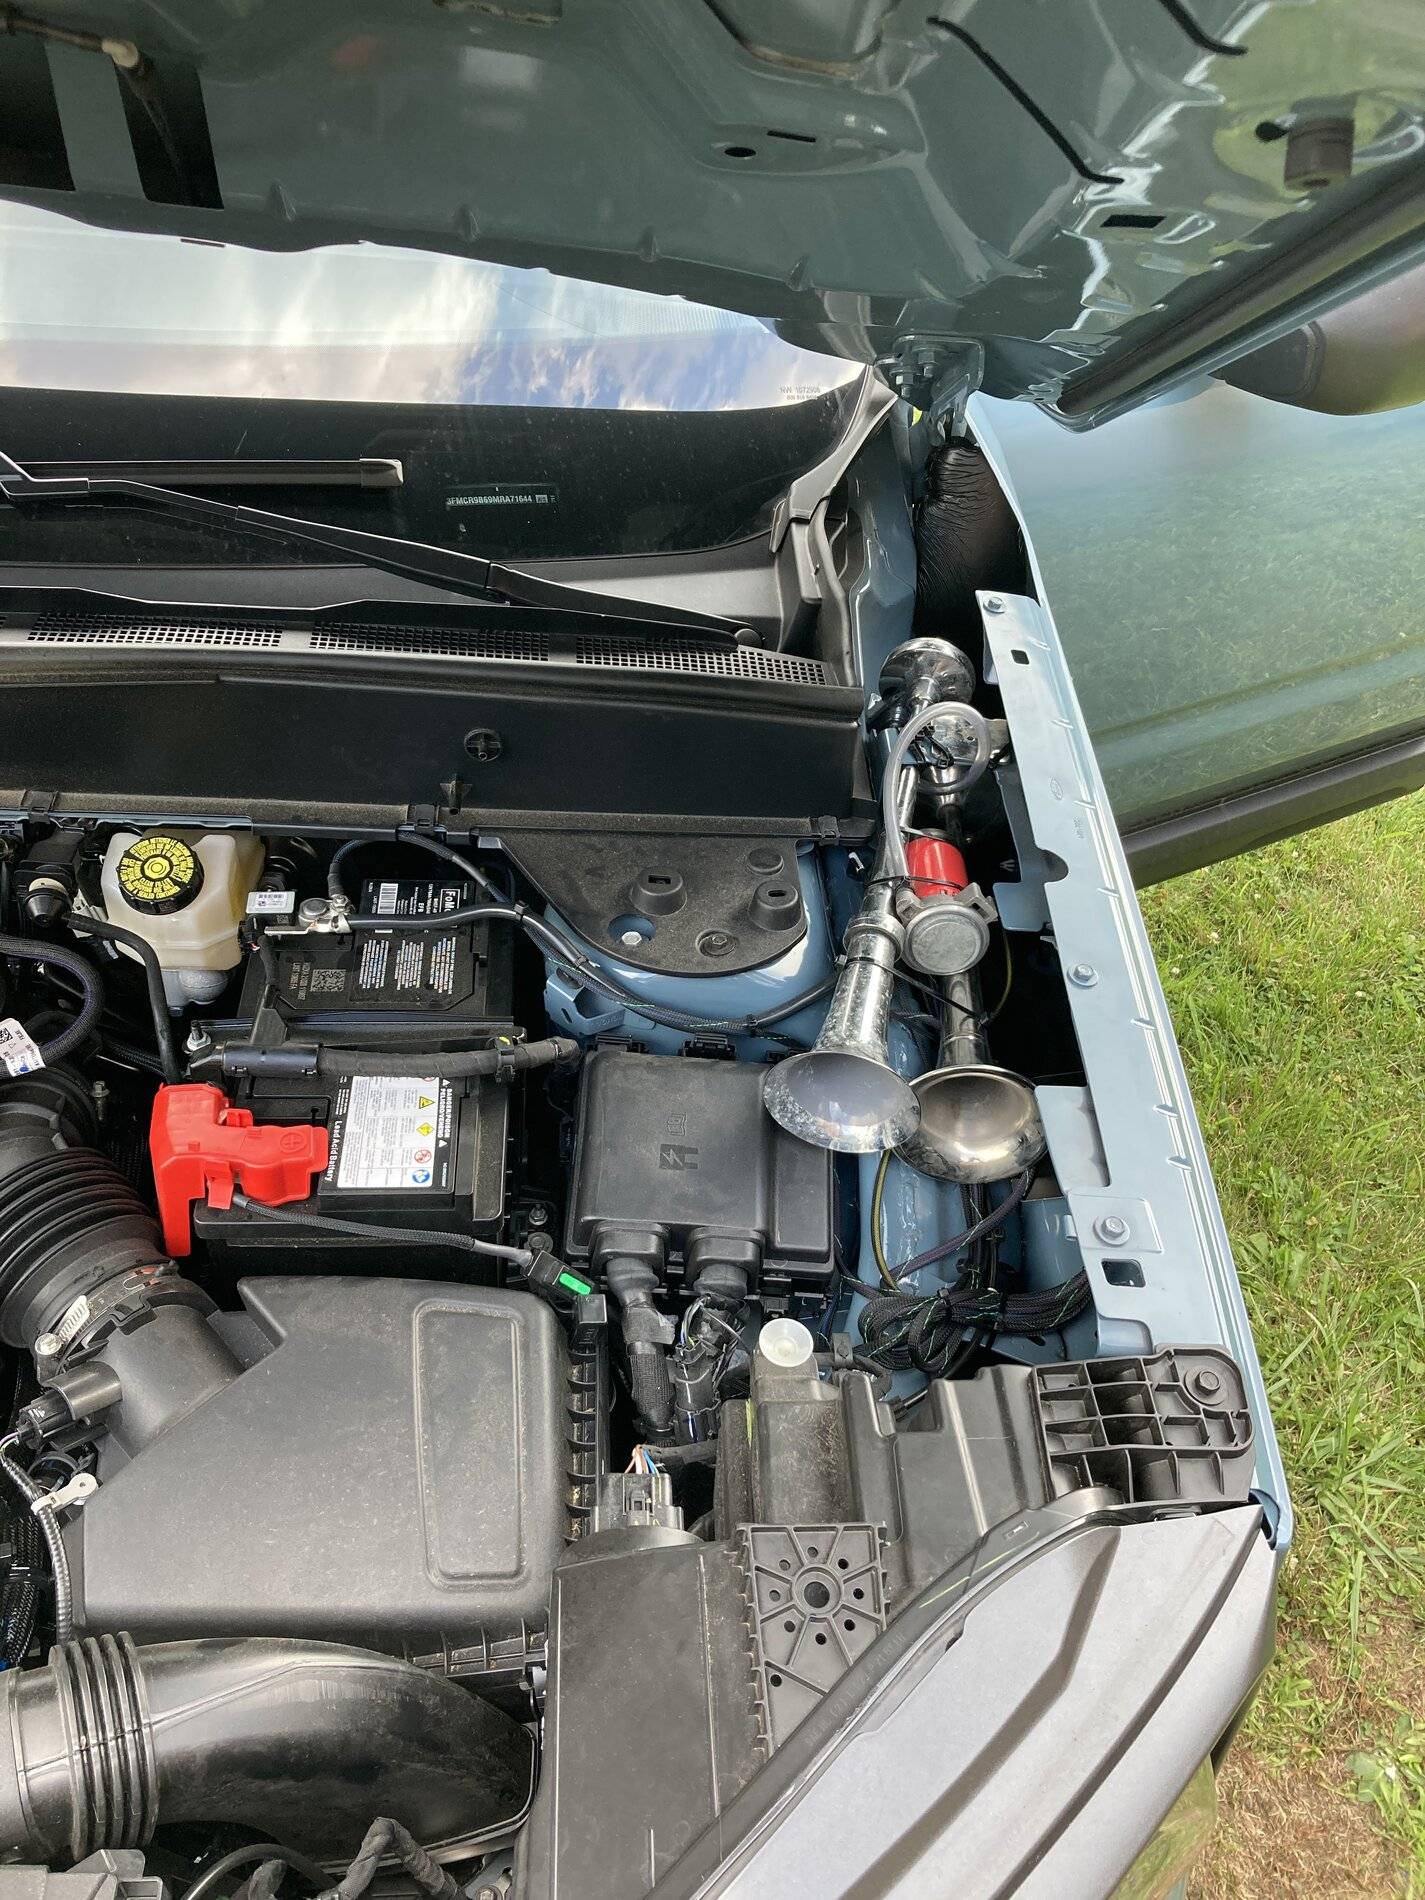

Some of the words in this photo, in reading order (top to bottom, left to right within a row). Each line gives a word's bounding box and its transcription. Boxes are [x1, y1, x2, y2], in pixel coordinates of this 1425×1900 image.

[333, 1120, 343, 1139] Lead
[330, 1139, 340, 1155] Acid
[324, 1155, 338, 1181] Battery
